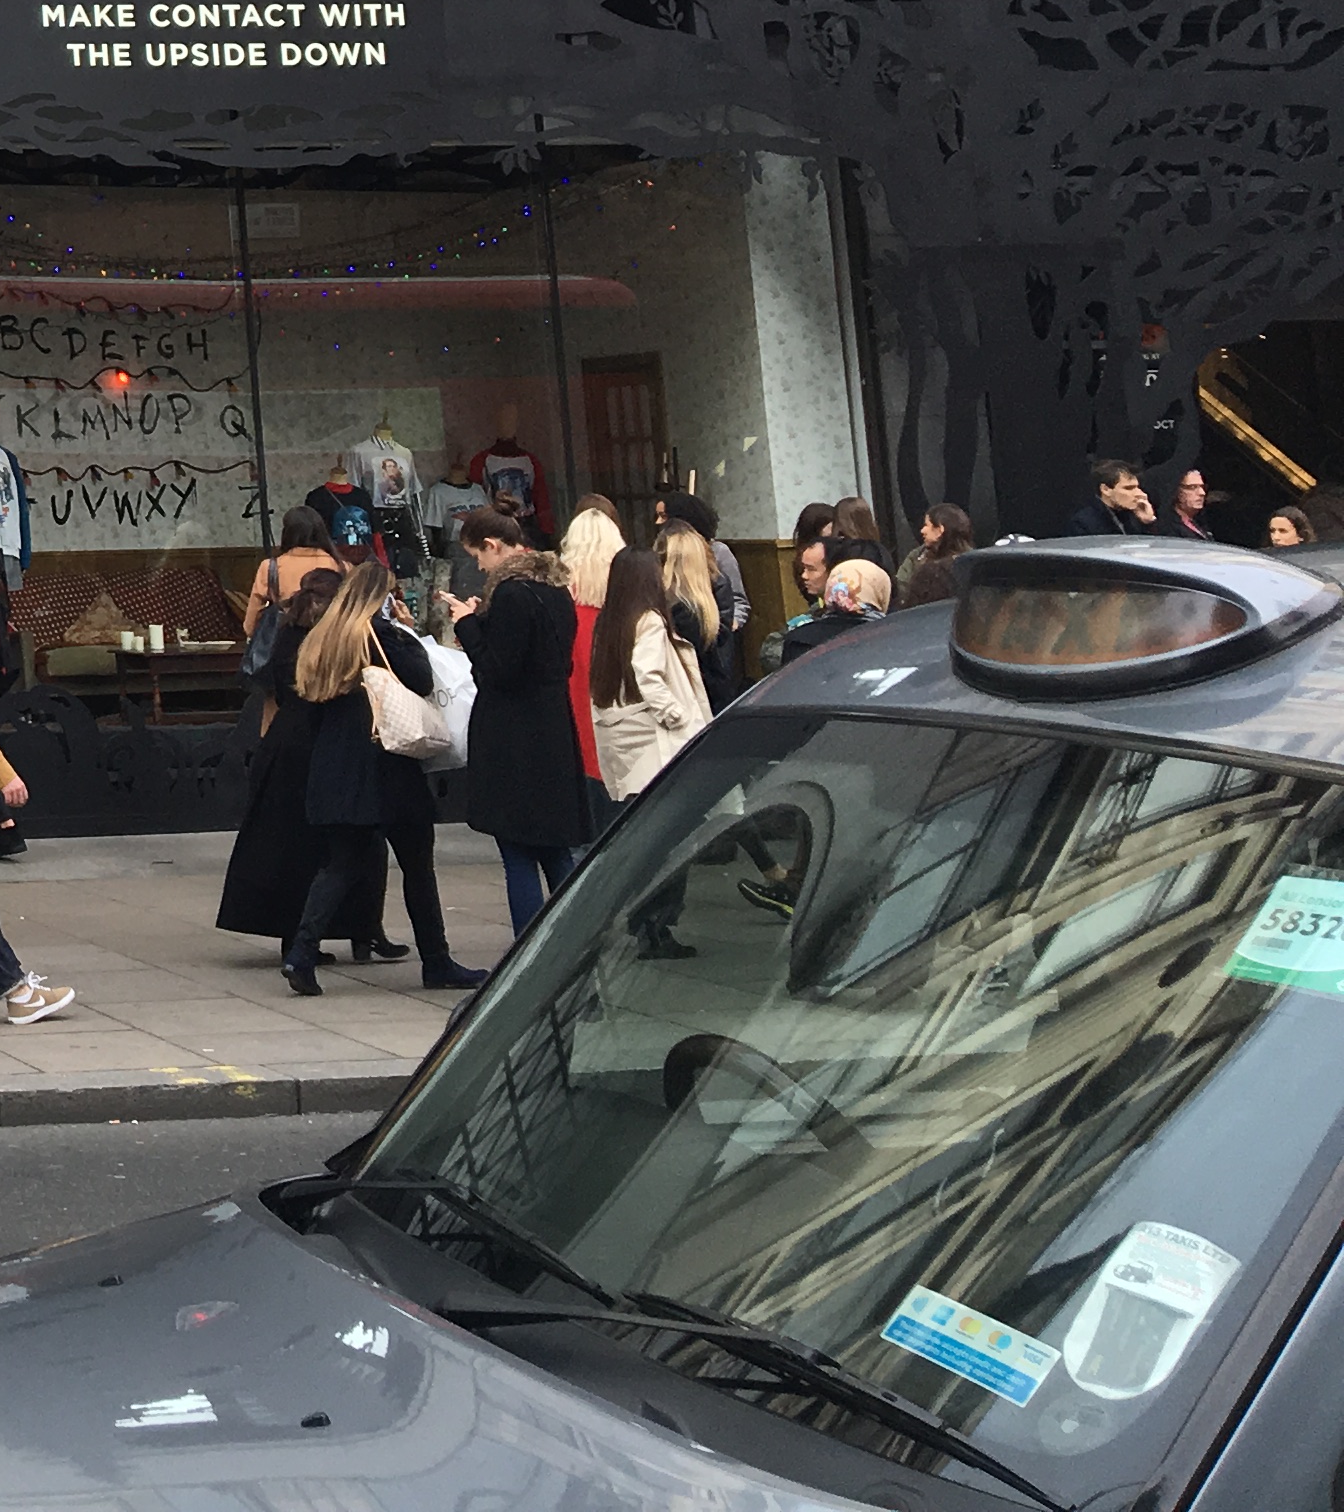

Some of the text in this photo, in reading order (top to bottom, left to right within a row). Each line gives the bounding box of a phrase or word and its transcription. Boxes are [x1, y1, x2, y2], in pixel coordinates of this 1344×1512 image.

[41, 2, 407, 29] MAKE CONTACT WITH
[67, 42, 387, 68] THE UPSIDE DOWN
[1164, 1230, 1201, 1251] TAXIS
